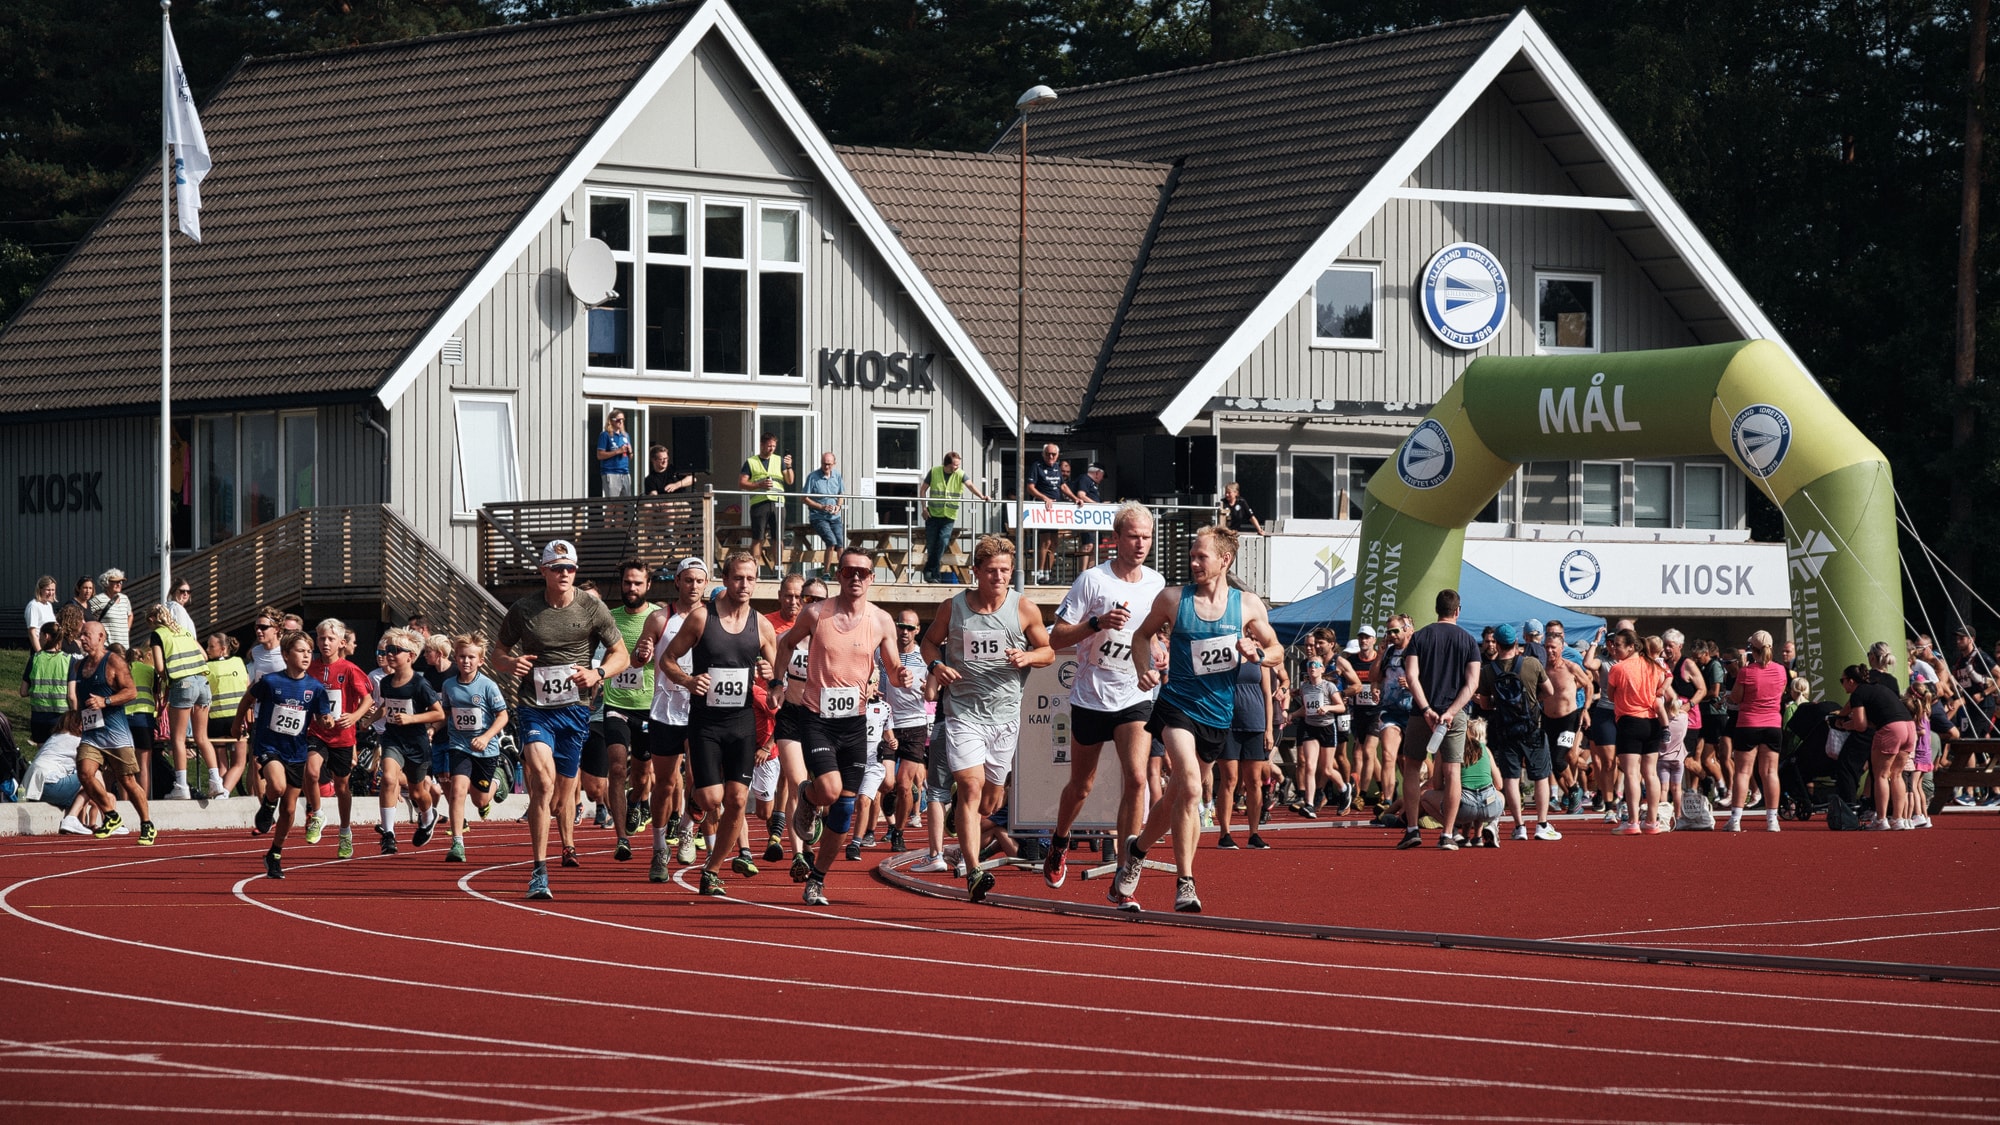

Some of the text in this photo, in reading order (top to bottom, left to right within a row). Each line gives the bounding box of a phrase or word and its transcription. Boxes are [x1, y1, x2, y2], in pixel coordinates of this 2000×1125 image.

[1428, 249, 1504, 293] LILLESAND IDRETTSLAG
[1440, 325, 1493, 343] STIFTET 1919
[819, 347, 936, 393] KIOSK
[1538, 372, 1642, 434] MÅL
[1759, 407, 1789, 435] IDRETTSLAG
[18, 471, 103, 515] KIOSK
[1360, 540, 1382, 628] ESANDS
[1376, 542, 1403, 638] REBANK
[1661, 564, 1755, 596] KIOSK
[1791, 589, 1806, 677] SPARE
[970, 640, 999, 654] 315
[1099, 640, 1132, 661] 477
[1804, 586, 1826, 703] LILLESAN
[793, 654, 808, 668] 45
[1200, 647, 1233, 666] 229
[541, 678, 573, 694] 434
[616, 673, 638, 685] 312
[713, 681, 744, 696] 493
[827, 696, 855, 711] 309
[83, 713, 98, 726] 247
[275, 714, 301, 730] 256
[456, 714, 477, 725] 299
